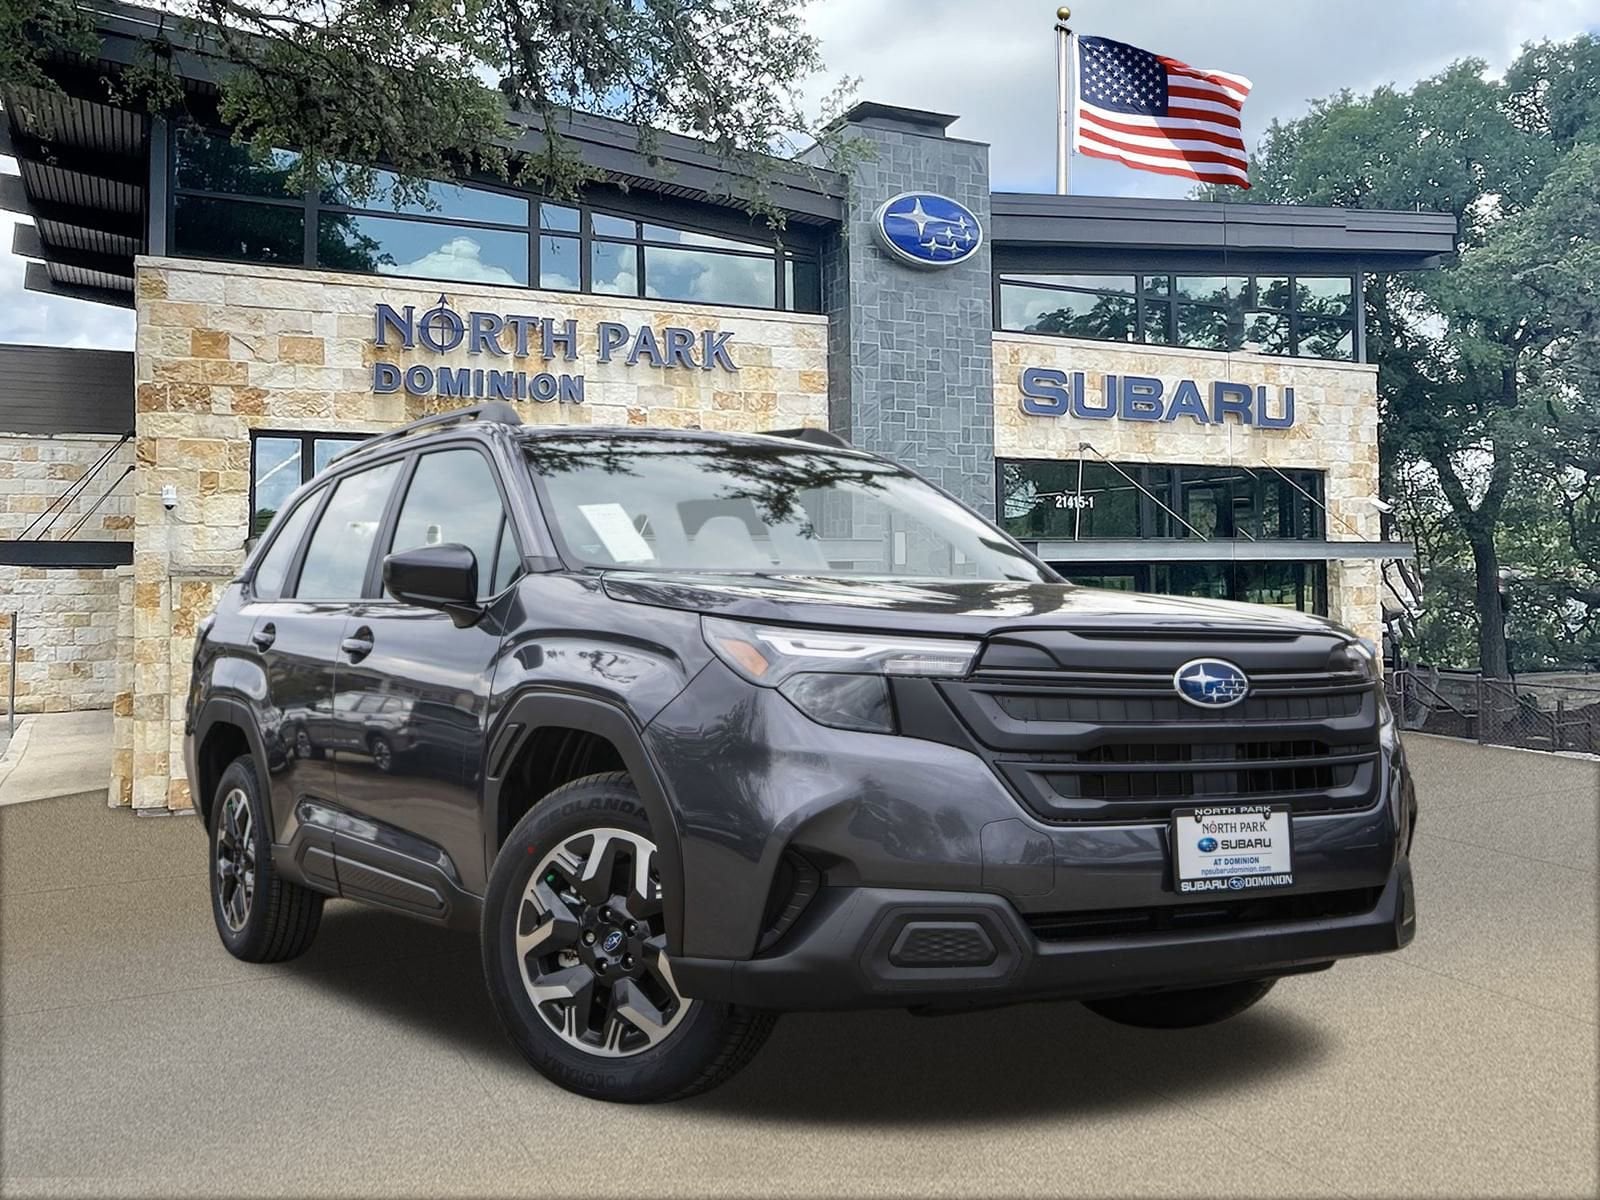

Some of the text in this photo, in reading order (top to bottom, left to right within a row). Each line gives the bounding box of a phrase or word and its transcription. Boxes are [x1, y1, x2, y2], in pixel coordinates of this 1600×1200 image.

[374, 300, 741, 373] NORTH PARK
[373, 361, 585, 403] DOMINION
[1019, 367, 1295, 429] SUBARU
[1055, 495, 1094, 509] 21415-1
[1195, 805, 1271, 816] NORTH PARK
[1202, 821, 1268, 834] NORTH PARK
[1221, 838, 1271, 850] SUBARU
[1213, 857, 1260, 866] AT DOMINION
[1201, 866, 1272, 876] npsubarudominion.com
[1181, 875, 1293, 892] SUBARU DOMINION
